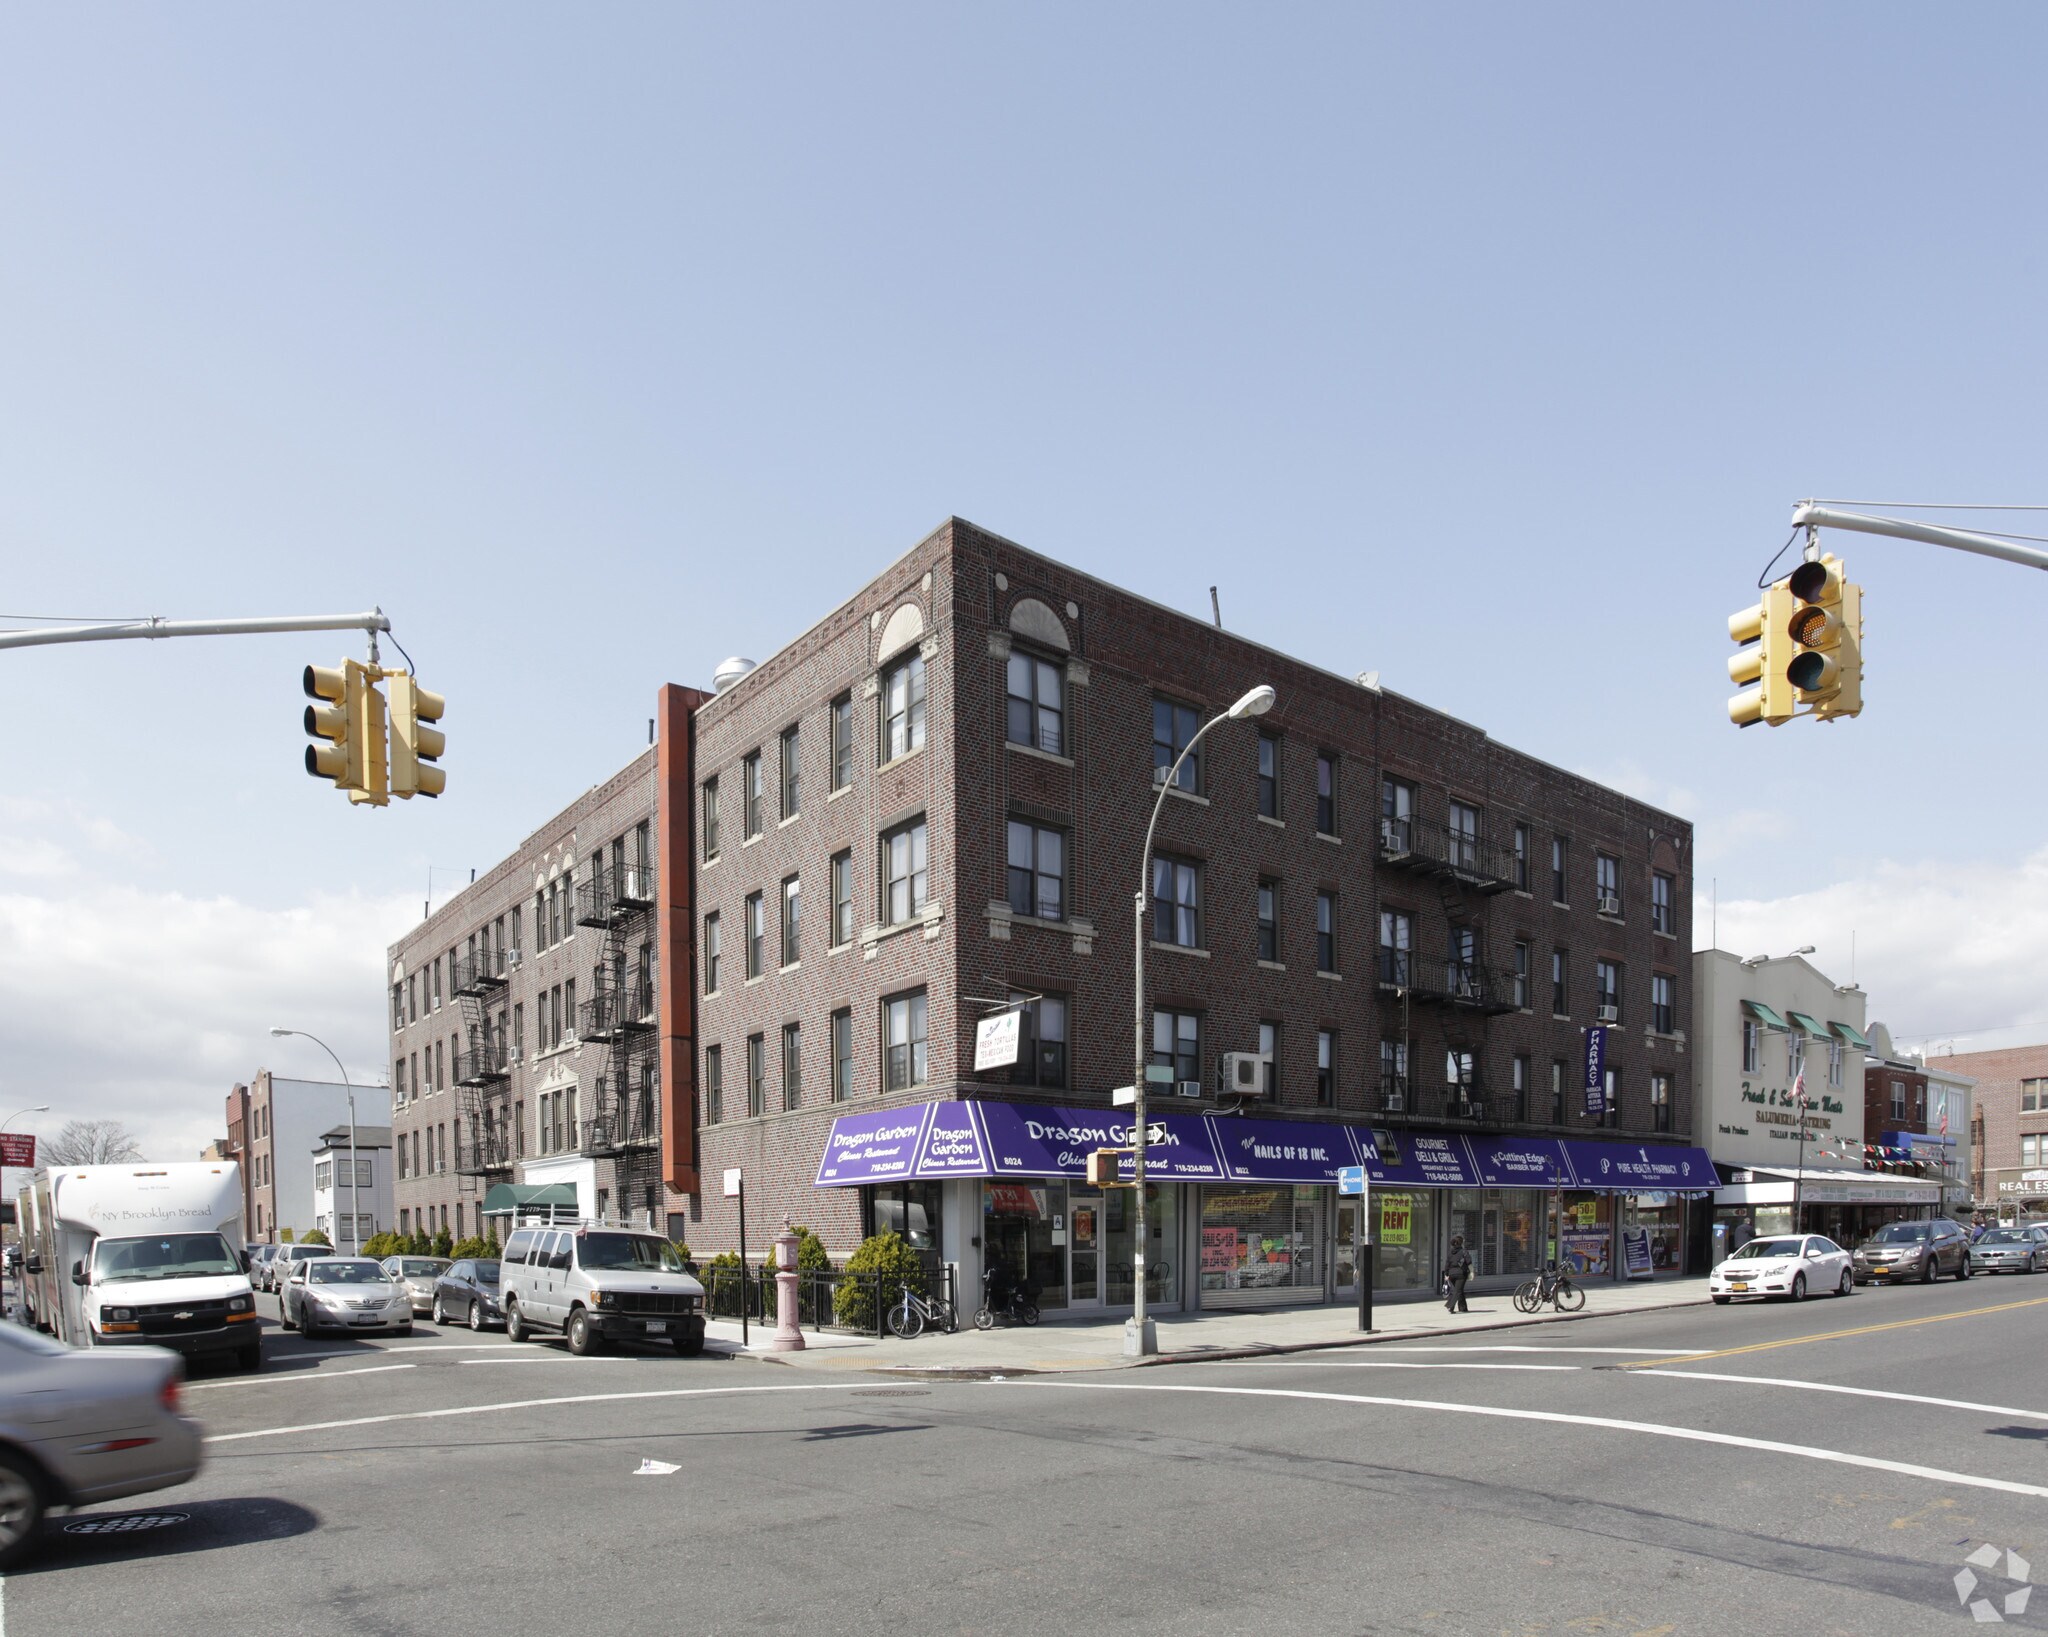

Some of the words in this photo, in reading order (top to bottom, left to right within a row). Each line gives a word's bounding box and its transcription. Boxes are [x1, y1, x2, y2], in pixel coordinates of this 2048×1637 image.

[1588, 1030, 1600, 1086] PHARMACY
[1756, 1110, 1797, 1126] SALUMERIA
[1799, 1117, 1831, 1129] ATERING
[834, 1133, 874, 1148] Dragon
[875, 1125, 917, 1142] Garden
[933, 1128, 973, 1144] Dragon
[1025, 1120, 1107, 1146] Dragon
[1769, 1130, 1788, 1139] ITALIAN
[931, 1142, 973, 1156] Garden
[1415, 1138, 1449, 1150] GOURMET
[837, 1150, 862, 1163] Chinese
[1253, 1144, 1282, 1159] NAILS
[1283, 1146, 1296, 1160] OF
[1298, 1147, 1308, 1161] 18
[1310, 1148, 1330, 1161] INC.
[1362, 1143, 1379, 1160] A1
[1415, 1151, 1432, 1162] DELI
[1431, 1152, 1439, 1163] &
[1437, 1152, 1459, 1163] GRILL
[1497, 1151, 1526, 1164] Cutting
[1525, 1153, 1546, 1165] Edge
[922, 1159, 945, 1168] Chinese
[947, 1157, 981, 1166] Restaurant
[1004, 1157, 1022, 1166] 8024
[1057, 1151, 1088, 1166] Chin
[1118, 1157, 1168, 1169] estarant
[1506, 1163, 1530, 1171] BARBER
[1529, 1164, 1544, 1172] SHOP
[1616, 1162, 1633, 1174] PURE
[1632, 1163, 1652, 1174] HEALTH
[1651, 1164, 1678, 1175] PHARMACY
[1343, 1176, 1362, 1184] PHONE
[1999, 1181, 2032, 1192] REAL
[1384, 1198, 1409, 1207] STORE
[102, 1212, 119, 1221] NY
[122, 1207, 176, 1219] Brooklyn
[178, 1204, 211, 1217] Bread
[1055, 1216, 1062, 1226] A
[1383, 1211, 1409, 1230] RENT
